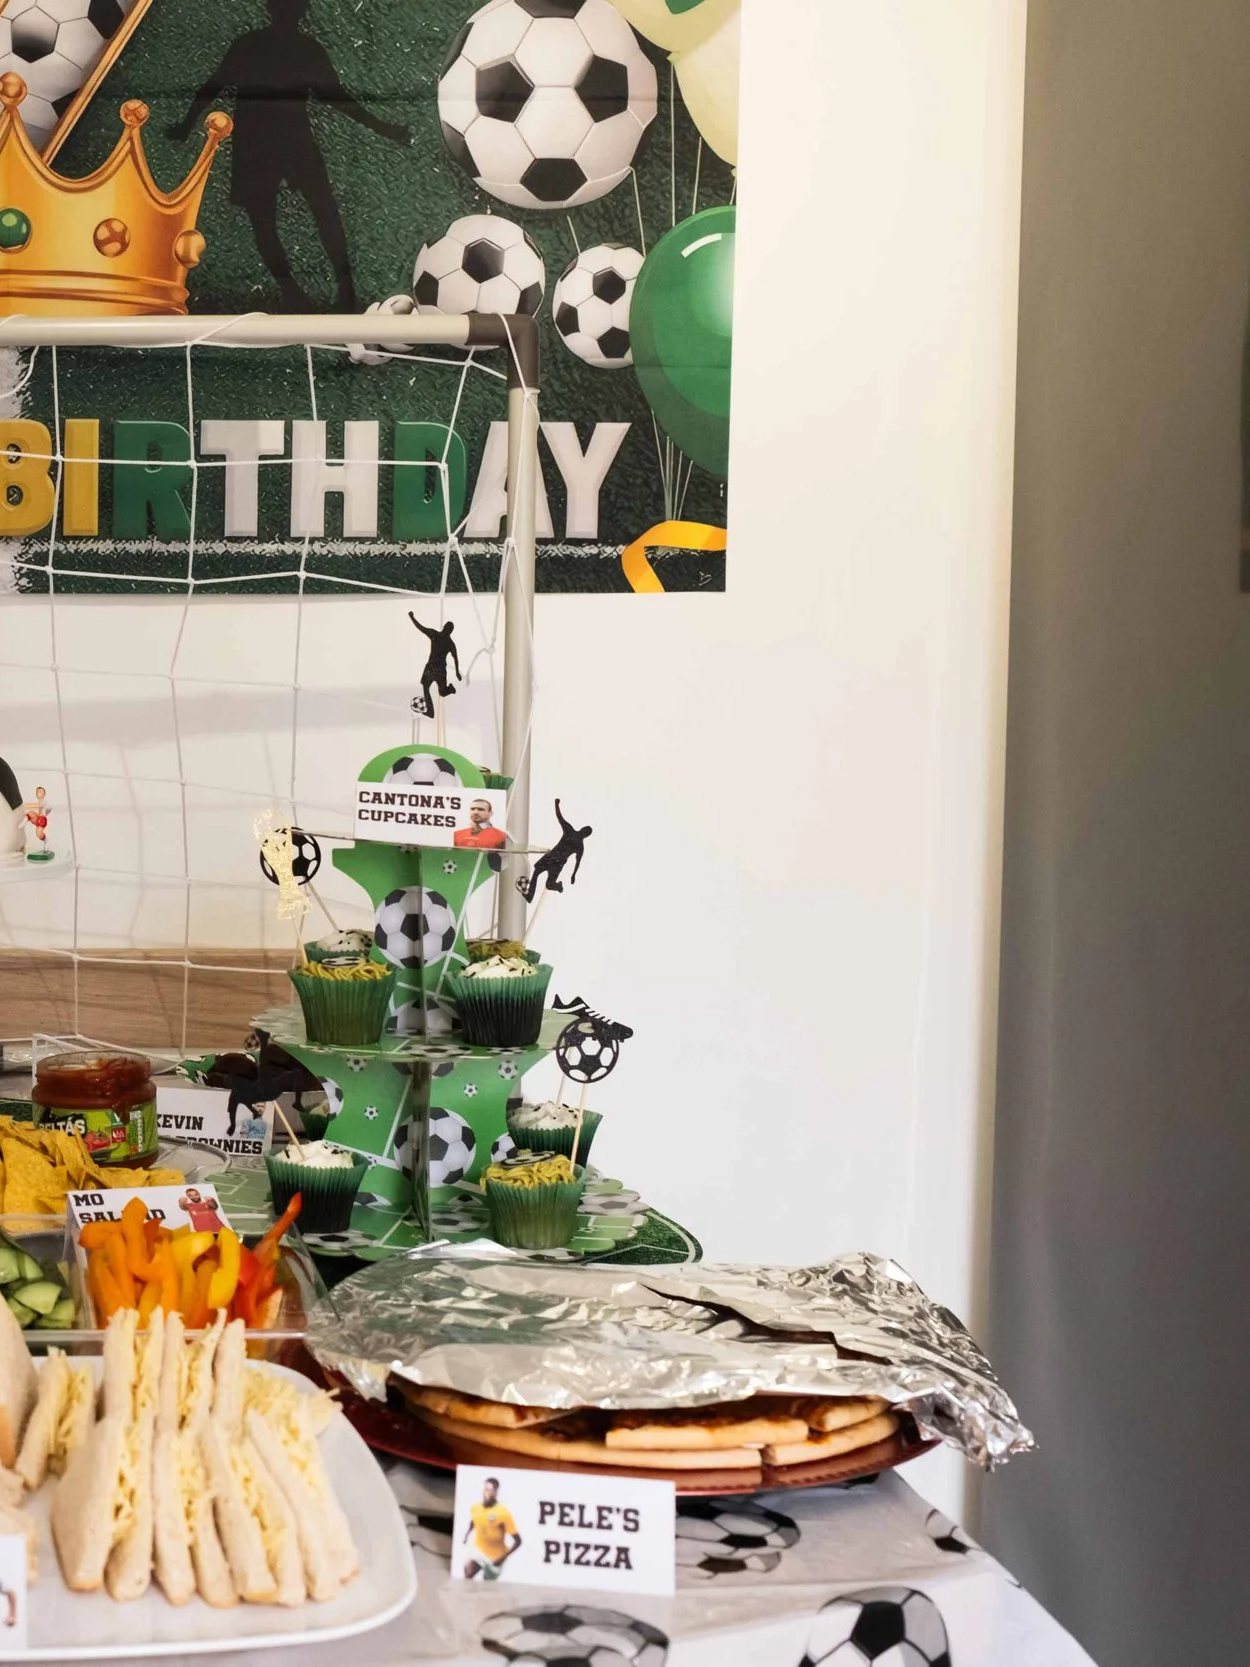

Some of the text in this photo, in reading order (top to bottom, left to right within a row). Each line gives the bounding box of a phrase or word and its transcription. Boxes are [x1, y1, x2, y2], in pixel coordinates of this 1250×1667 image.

[358, 790, 462, 811] CANTONA'S
[357, 808, 457, 828] CUPCAKES
[72, 1193, 105, 1207] MO
[538, 1500, 640, 1533] PELE'S
[543, 1539, 633, 1570] PIZZA
